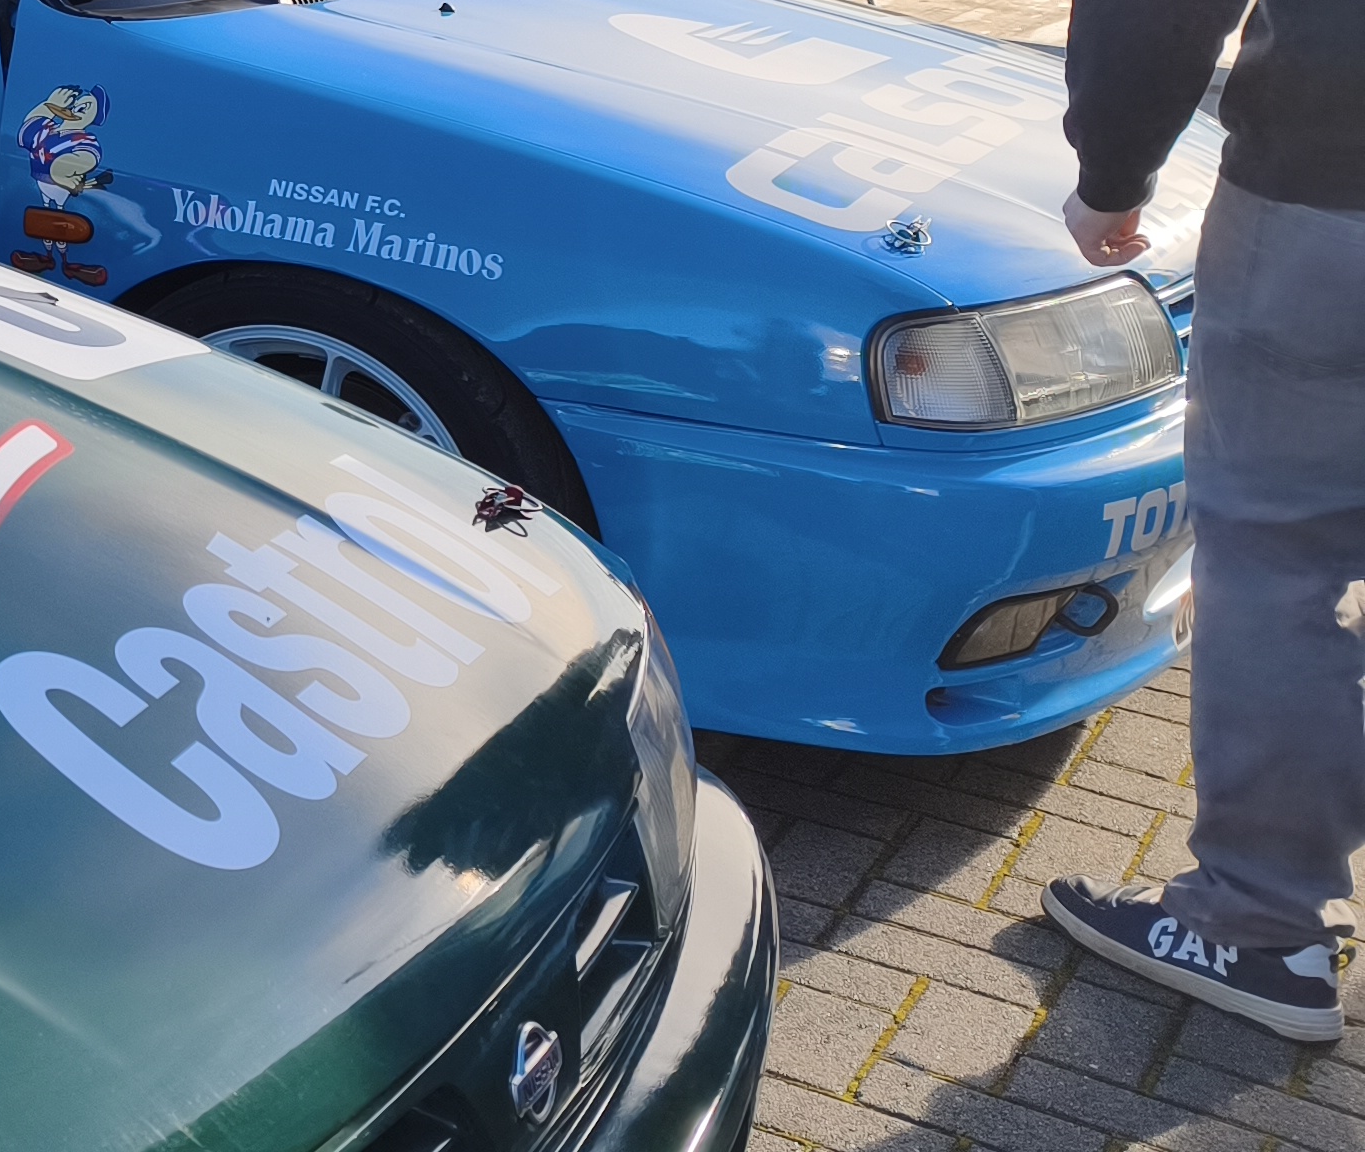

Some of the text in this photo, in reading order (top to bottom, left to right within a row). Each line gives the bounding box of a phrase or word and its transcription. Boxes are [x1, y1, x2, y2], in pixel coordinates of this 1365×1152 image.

[172, 186, 505, 281] Yokohama Marinos
[268, 178, 407, 219] NISSAN F.C.
[1102, 480, 1189, 560] TOT
